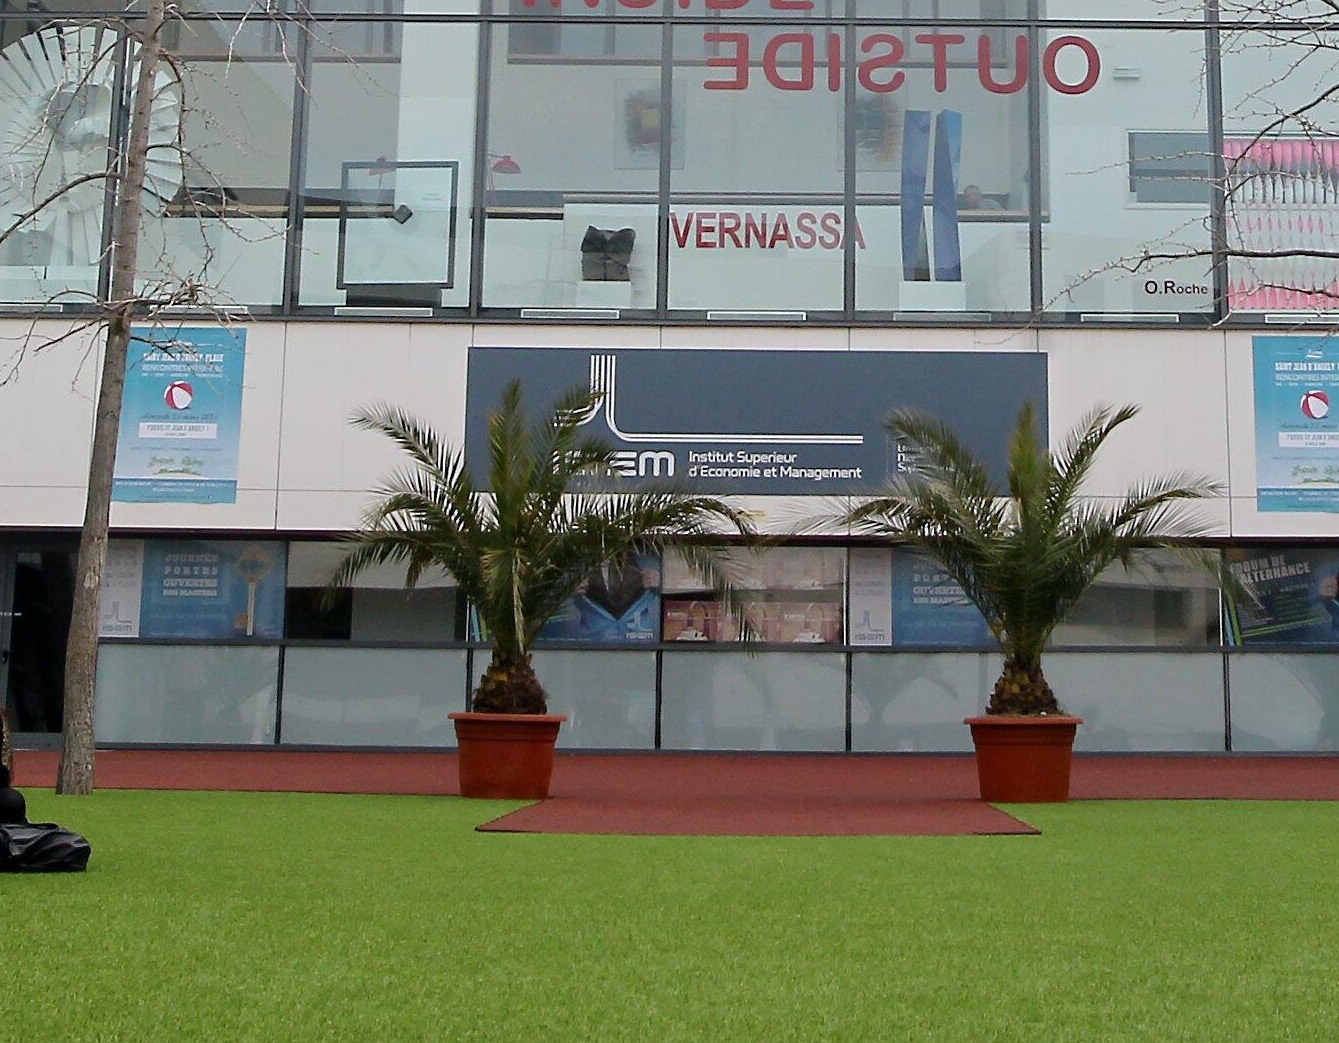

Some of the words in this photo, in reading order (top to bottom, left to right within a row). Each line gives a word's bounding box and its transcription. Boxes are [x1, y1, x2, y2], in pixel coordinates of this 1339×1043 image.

[669, 211, 866, 250] VERNASSA
[689, 451, 733, 464] Institut
[737, 451, 797, 467] Superieur
[764, 467, 776, 477] et
[780, 467, 862, 481] Management
